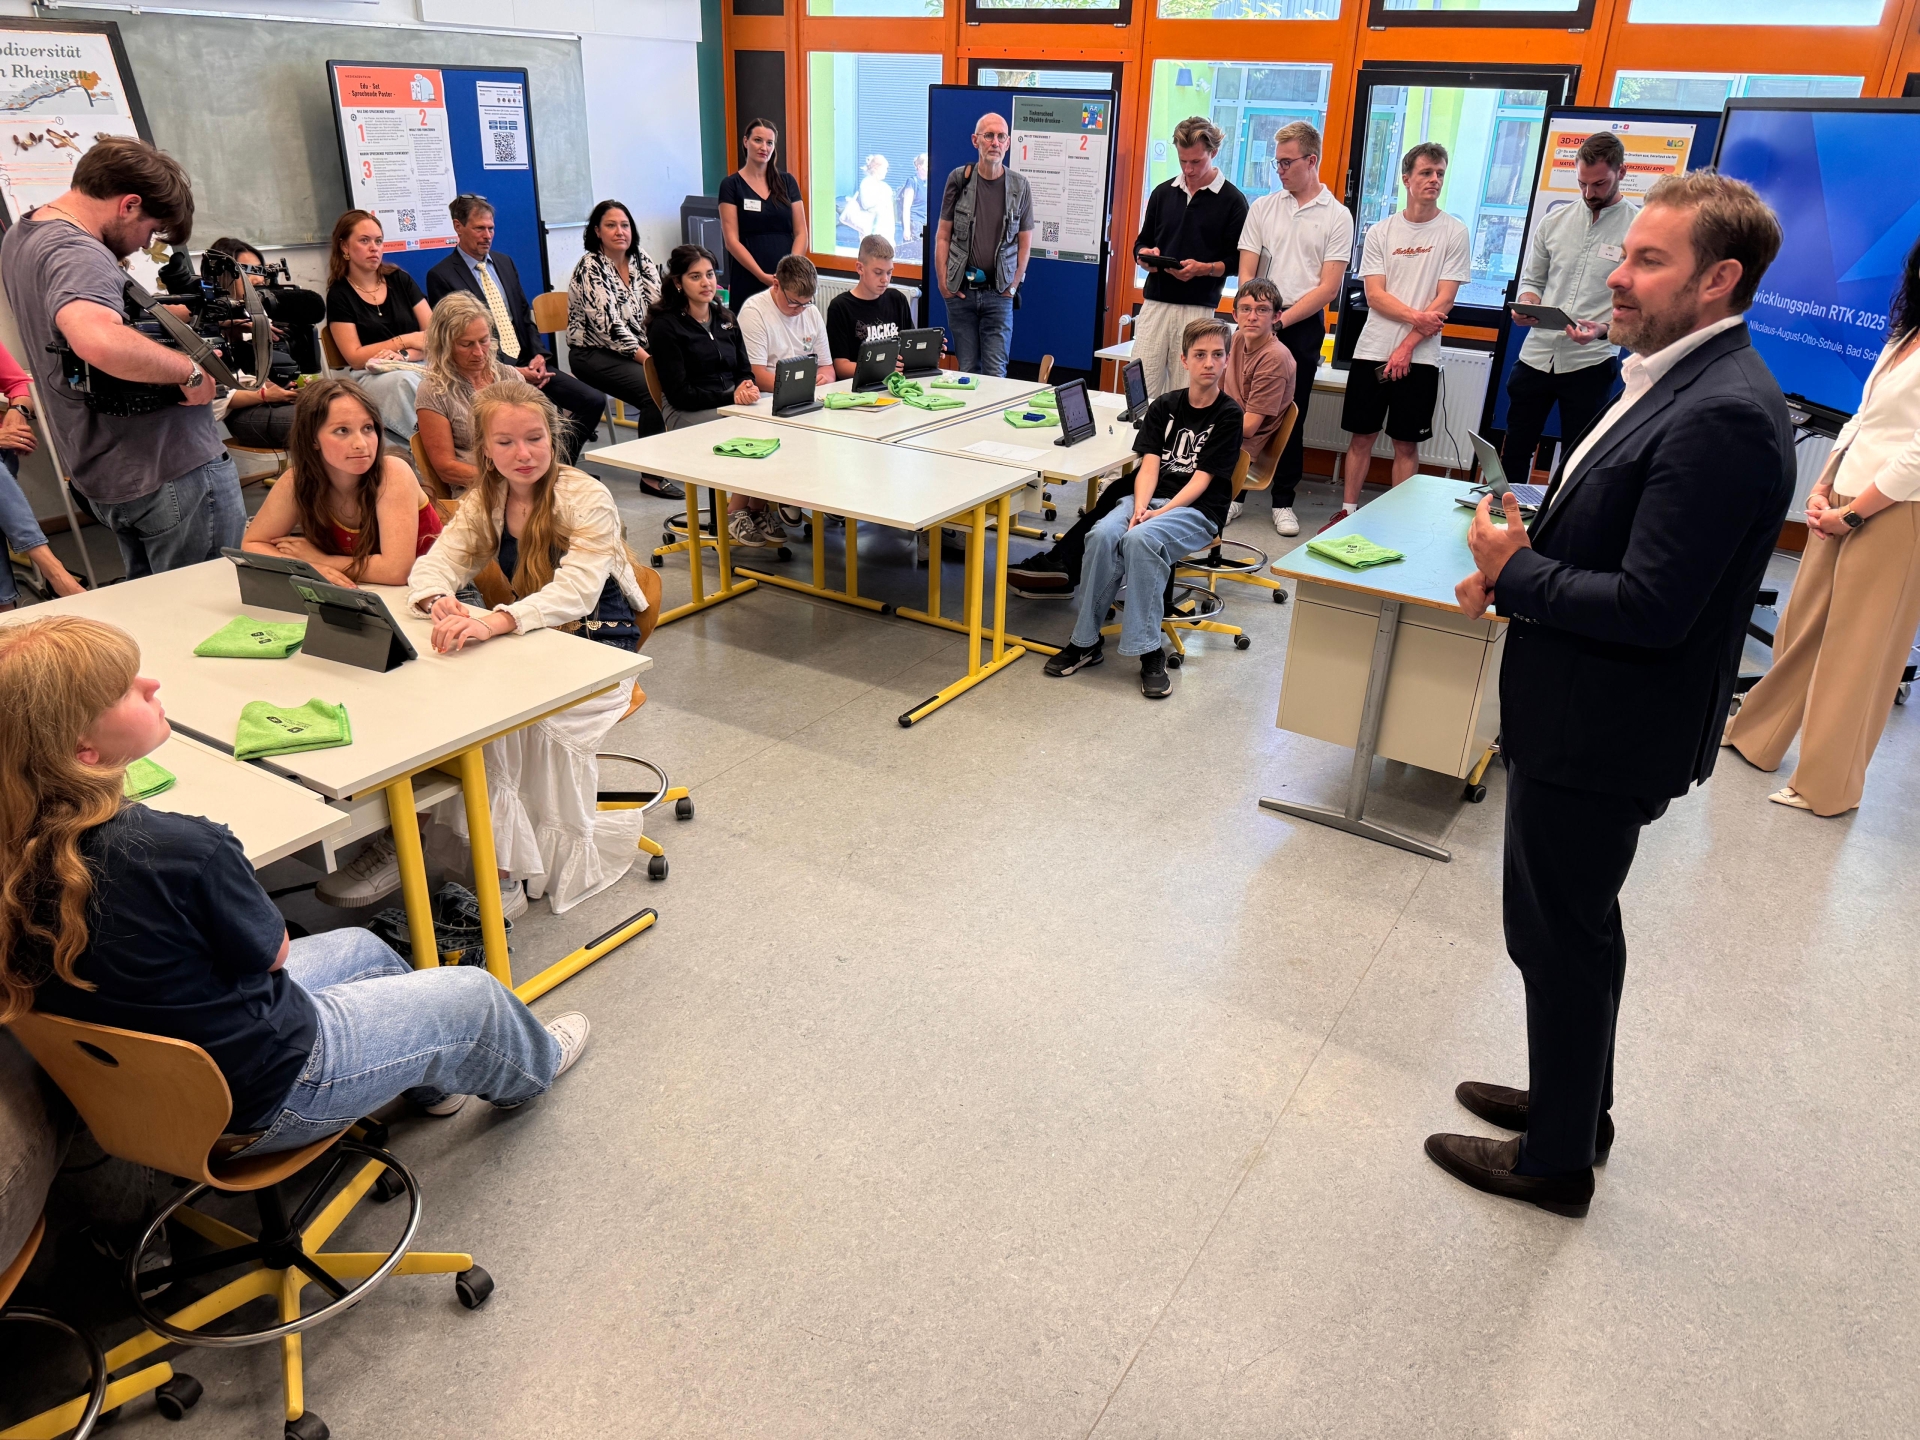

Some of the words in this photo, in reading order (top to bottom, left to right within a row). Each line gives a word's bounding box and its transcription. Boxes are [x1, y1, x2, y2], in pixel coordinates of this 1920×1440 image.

[11, 64, 91, 83] Rheingau
[419, 108, 428, 127] 2
[358, 123, 366, 142] 1
[1079, 134, 1089, 151] 2
[1022, 144, 1028, 161] 1
[363, 160, 373, 179] 3
[1752, 289, 1826, 317] wicklungsplan
[1828, 304, 1856, 324] RTK
[1855, 310, 1887, 331] 2025
[905, 340, 912, 349] 5
[1750, 319, 1844, 354] Nikolaus-August-Otto-Schule,
[1846, 344, 1861, 358] Bad
[1862, 348, 1879, 361] Sch
[785, 370, 791, 381] 7
